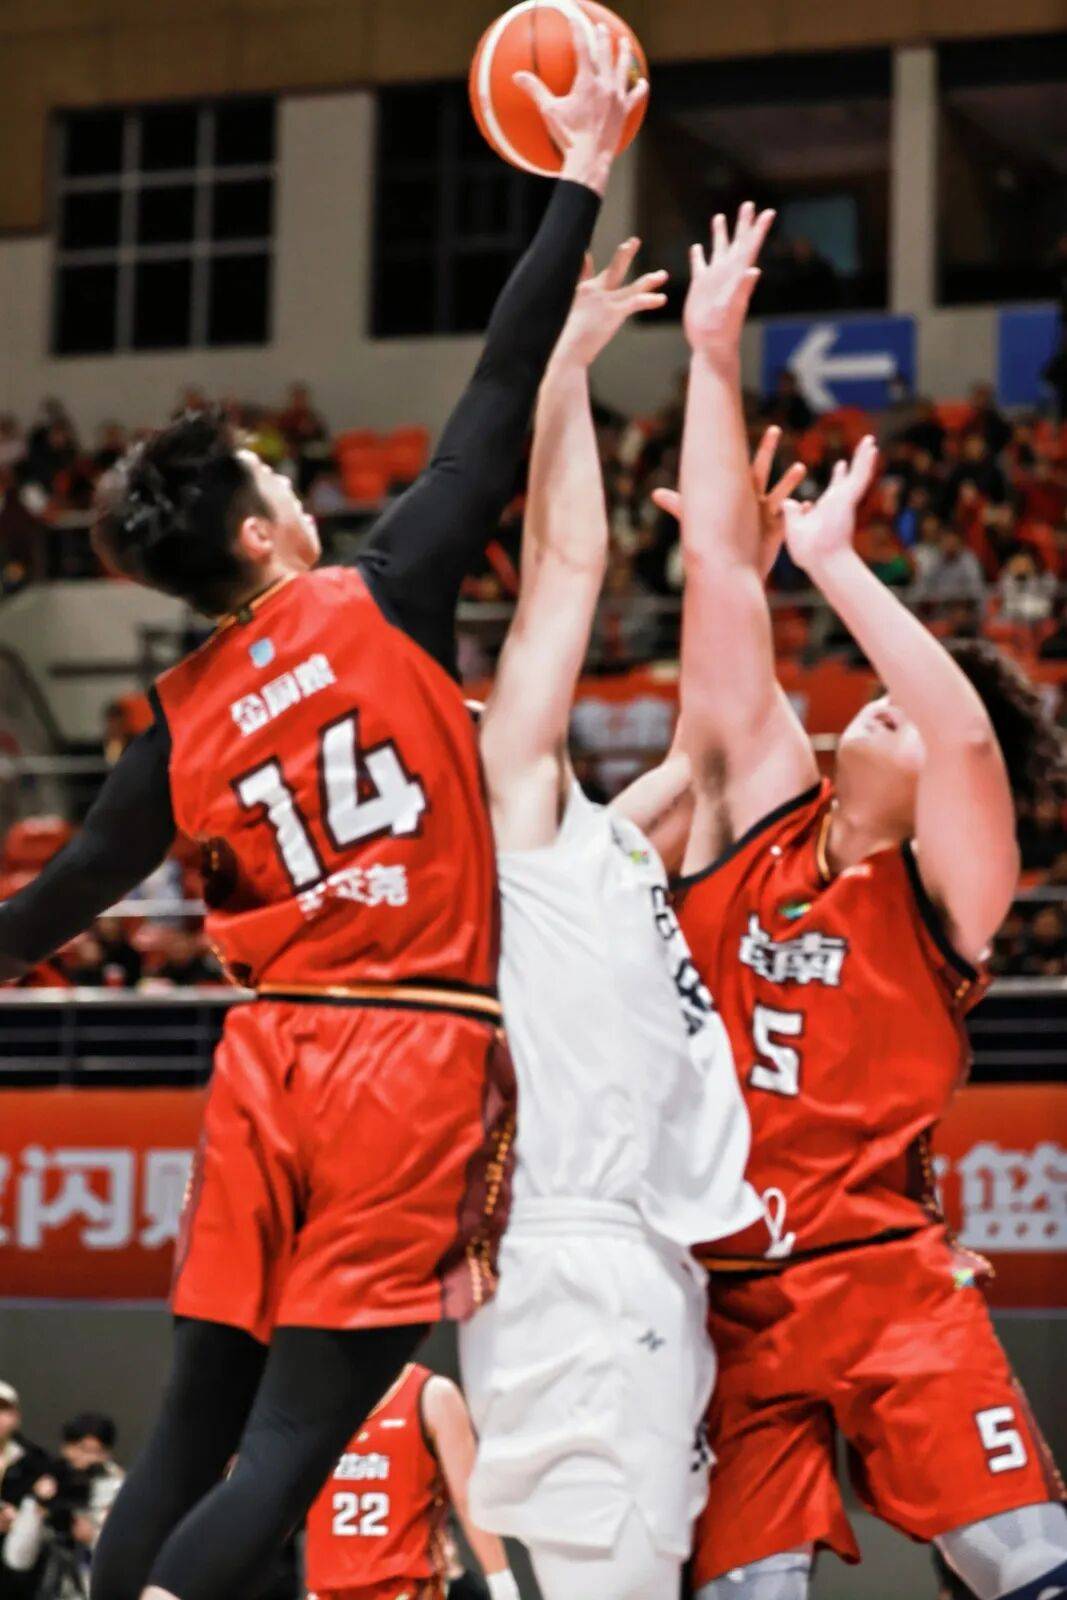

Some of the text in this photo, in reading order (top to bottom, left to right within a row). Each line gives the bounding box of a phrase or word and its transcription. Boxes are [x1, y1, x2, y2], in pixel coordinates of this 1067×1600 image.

[230, 708, 428, 895] 14
[749, 1003, 805, 1096] 5
[974, 1405, 1028, 1474] 5
[332, 1492, 389, 1536] 22
